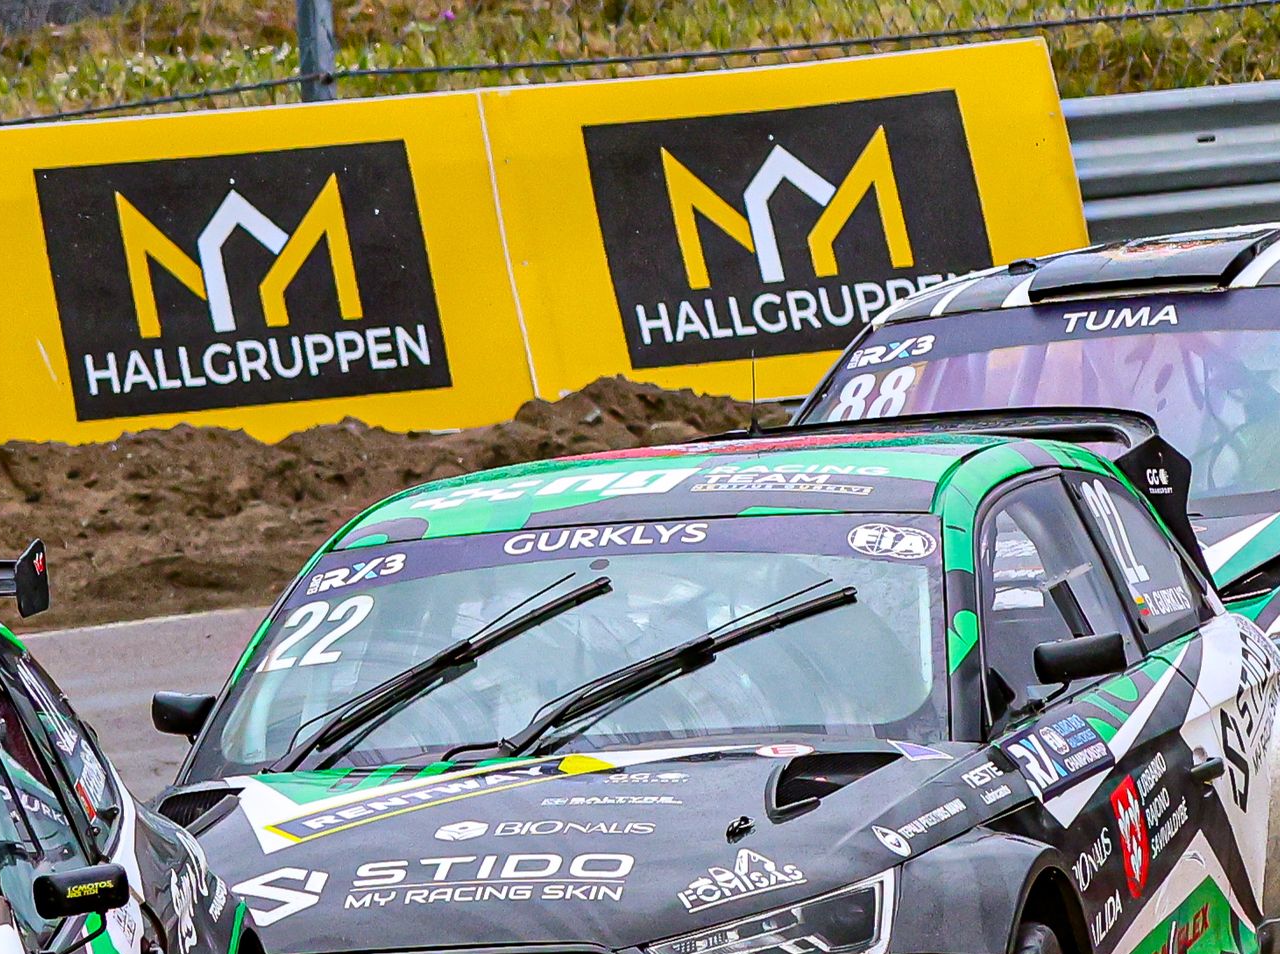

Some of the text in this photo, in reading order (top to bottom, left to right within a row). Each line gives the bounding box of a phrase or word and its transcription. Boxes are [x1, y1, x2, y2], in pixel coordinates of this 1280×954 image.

[636, 269, 982, 346] HALLGRUPP
[1063, 305, 1178, 333] TUMA
[84, 323, 431, 396] HALLGRUPPEN
[828, 366, 916, 422] 88
[703, 474, 832, 485] TEAM
[712, 464, 890, 476] RACING
[503, 522, 708, 554] GURKLYS
[255, 595, 374, 673] 22
[301, 766, 542, 830] RENTWAY
[494, 820, 656, 836] BIONALIS
[352, 852, 635, 889] STIDO
[344, 884, 625, 909] MY RACING SKIN
